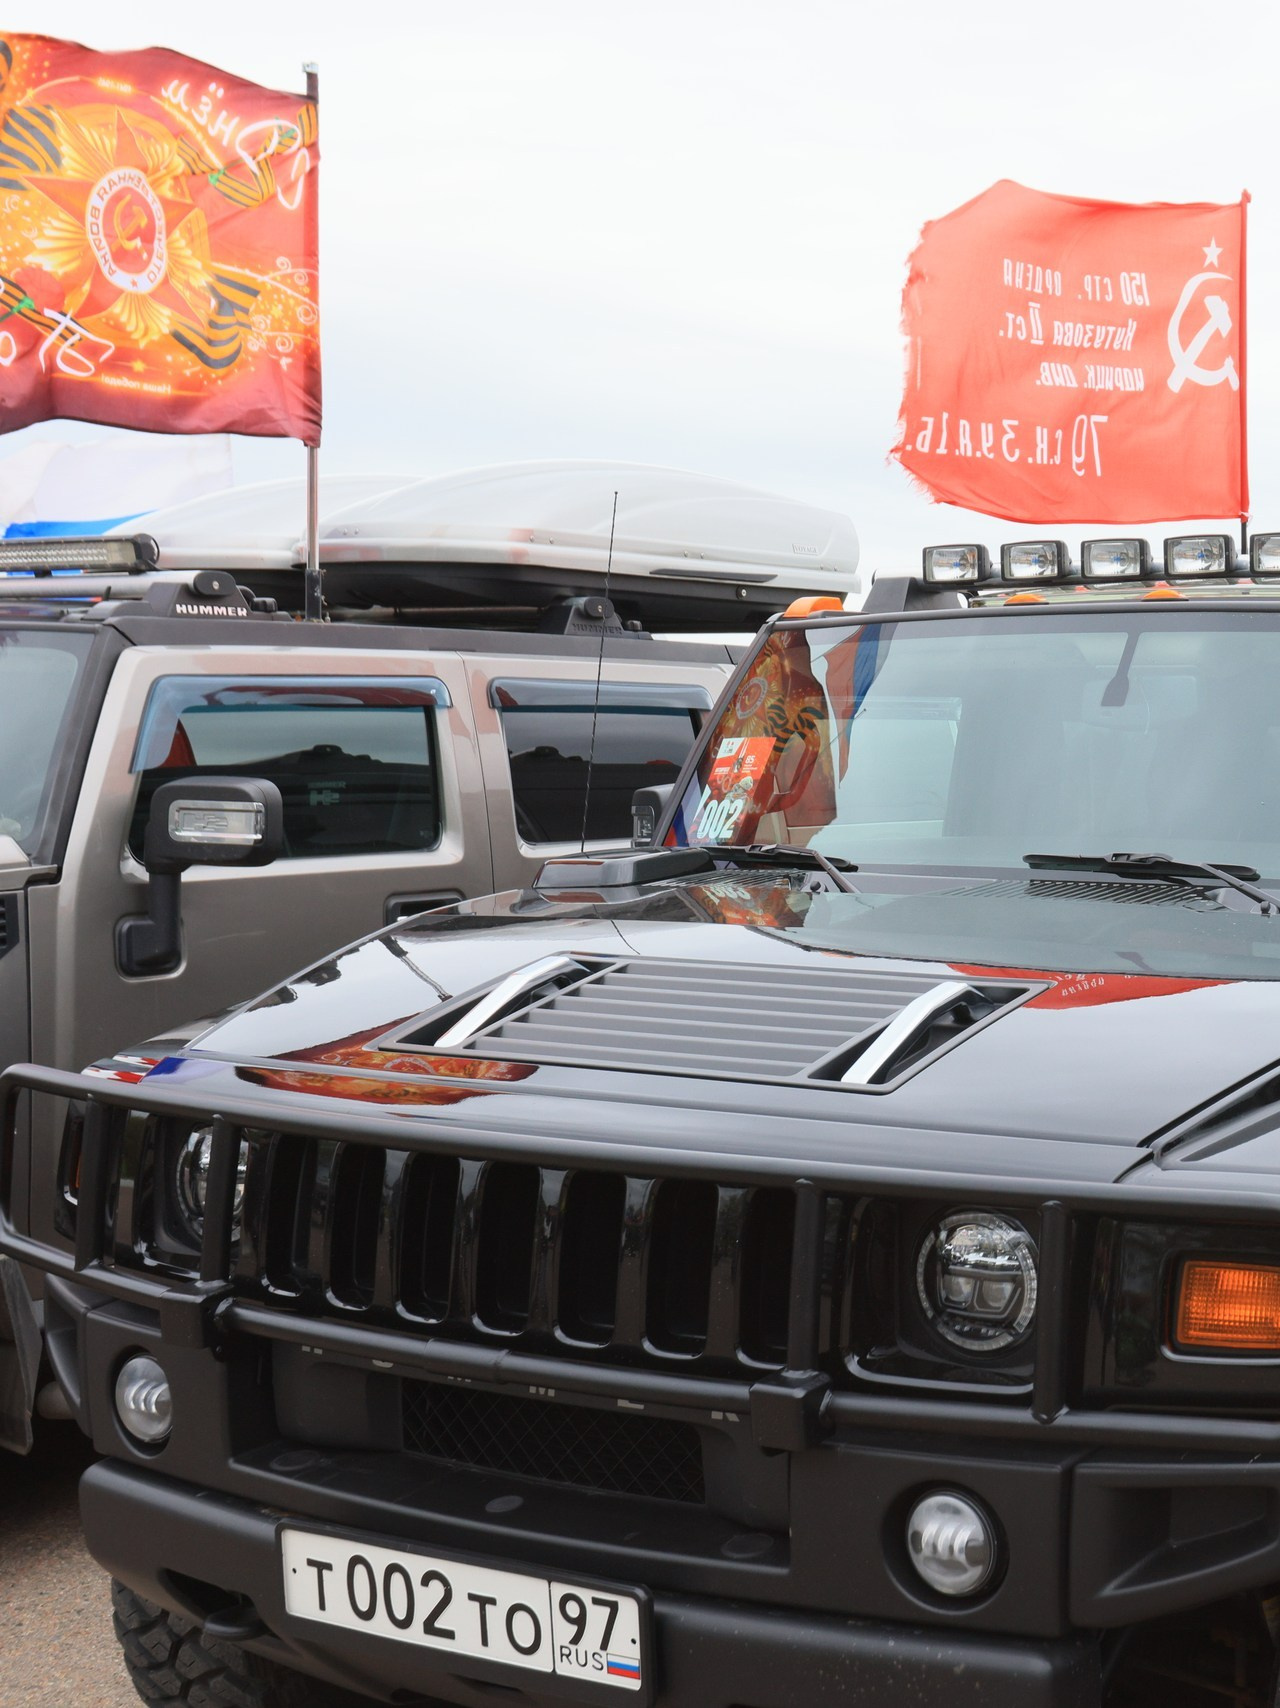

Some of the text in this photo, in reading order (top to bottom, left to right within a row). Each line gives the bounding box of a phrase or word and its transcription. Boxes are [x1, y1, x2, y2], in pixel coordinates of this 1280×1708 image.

[175, 603, 248, 617] HUMMER
[697, 798, 744, 840] 002
[558, 1592, 620, 1651] 97
[559, 1645, 605, 1671] RUS
